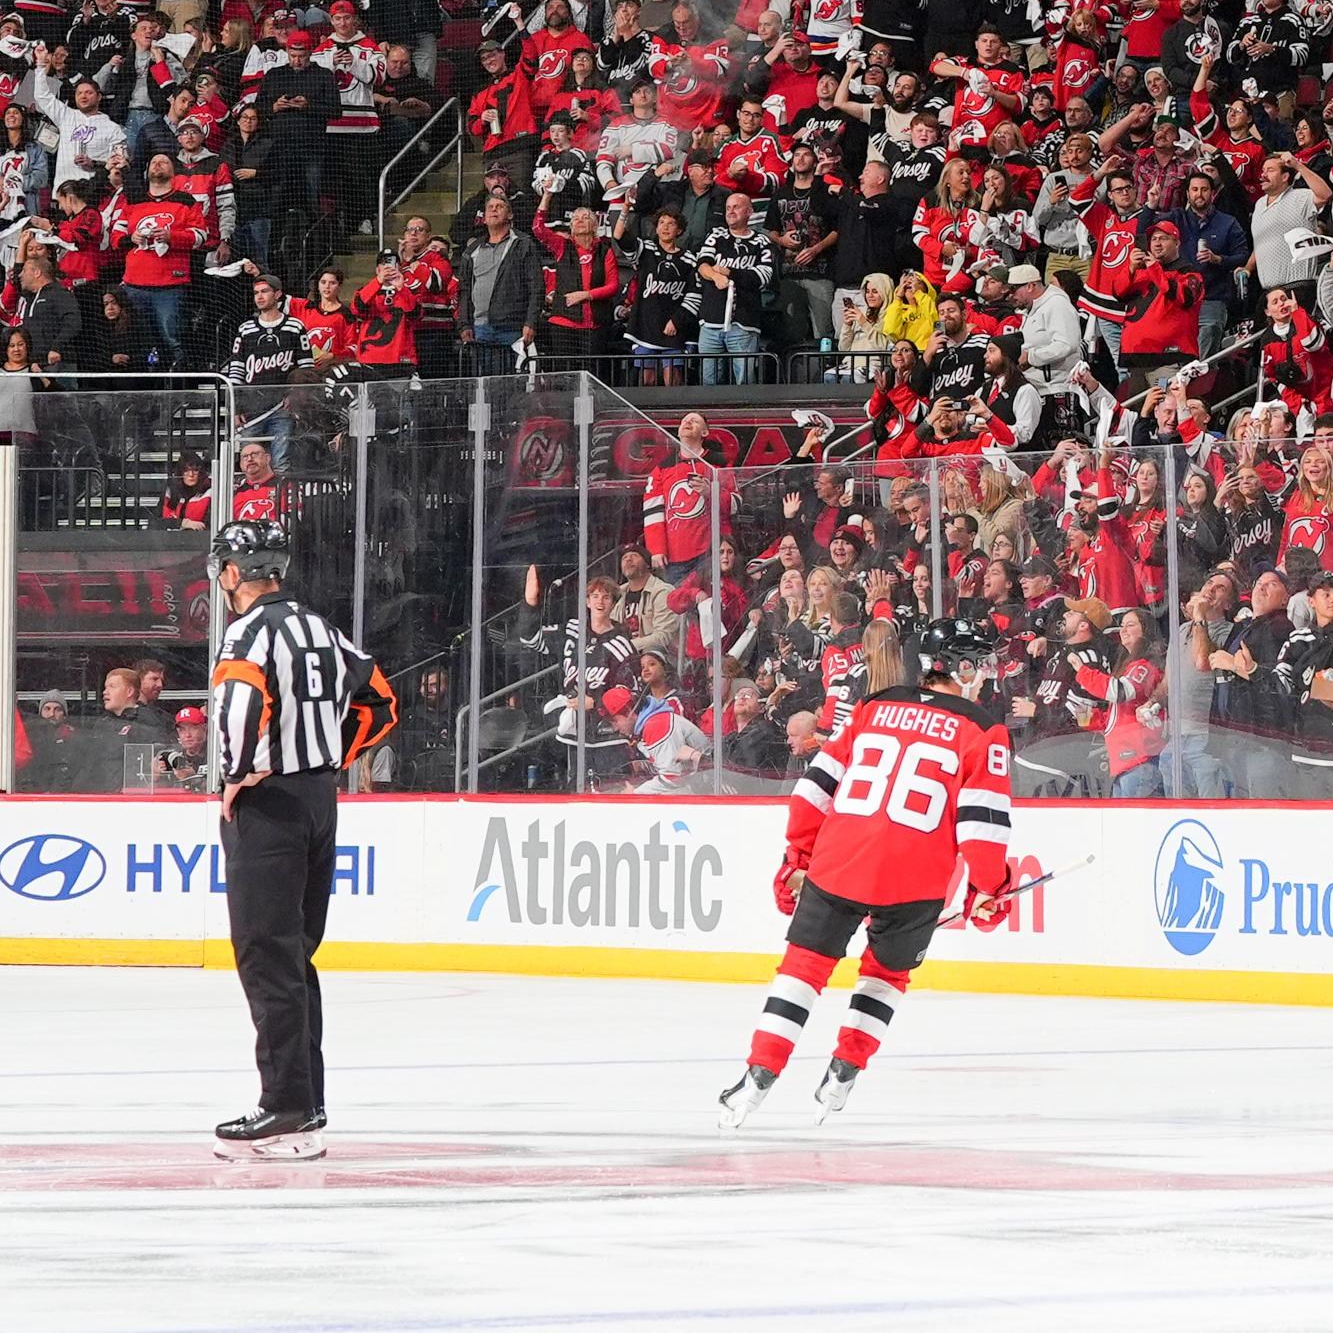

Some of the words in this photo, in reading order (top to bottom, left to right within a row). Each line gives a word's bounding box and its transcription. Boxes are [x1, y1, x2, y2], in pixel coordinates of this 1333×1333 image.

[891, 157, 932, 181] Jersey
[760, 250, 772, 265] 2
[643, 274, 685, 303] Jersey
[245, 350, 294, 382] Jersey
[306, 653, 321, 700] 6
[838, 684, 850, 701] 6
[873, 704, 960, 742] HUGHES
[987, 742, 1010, 776] 8
[833, 733, 960, 834] 86
[466, 817, 723, 931] Atlantic
